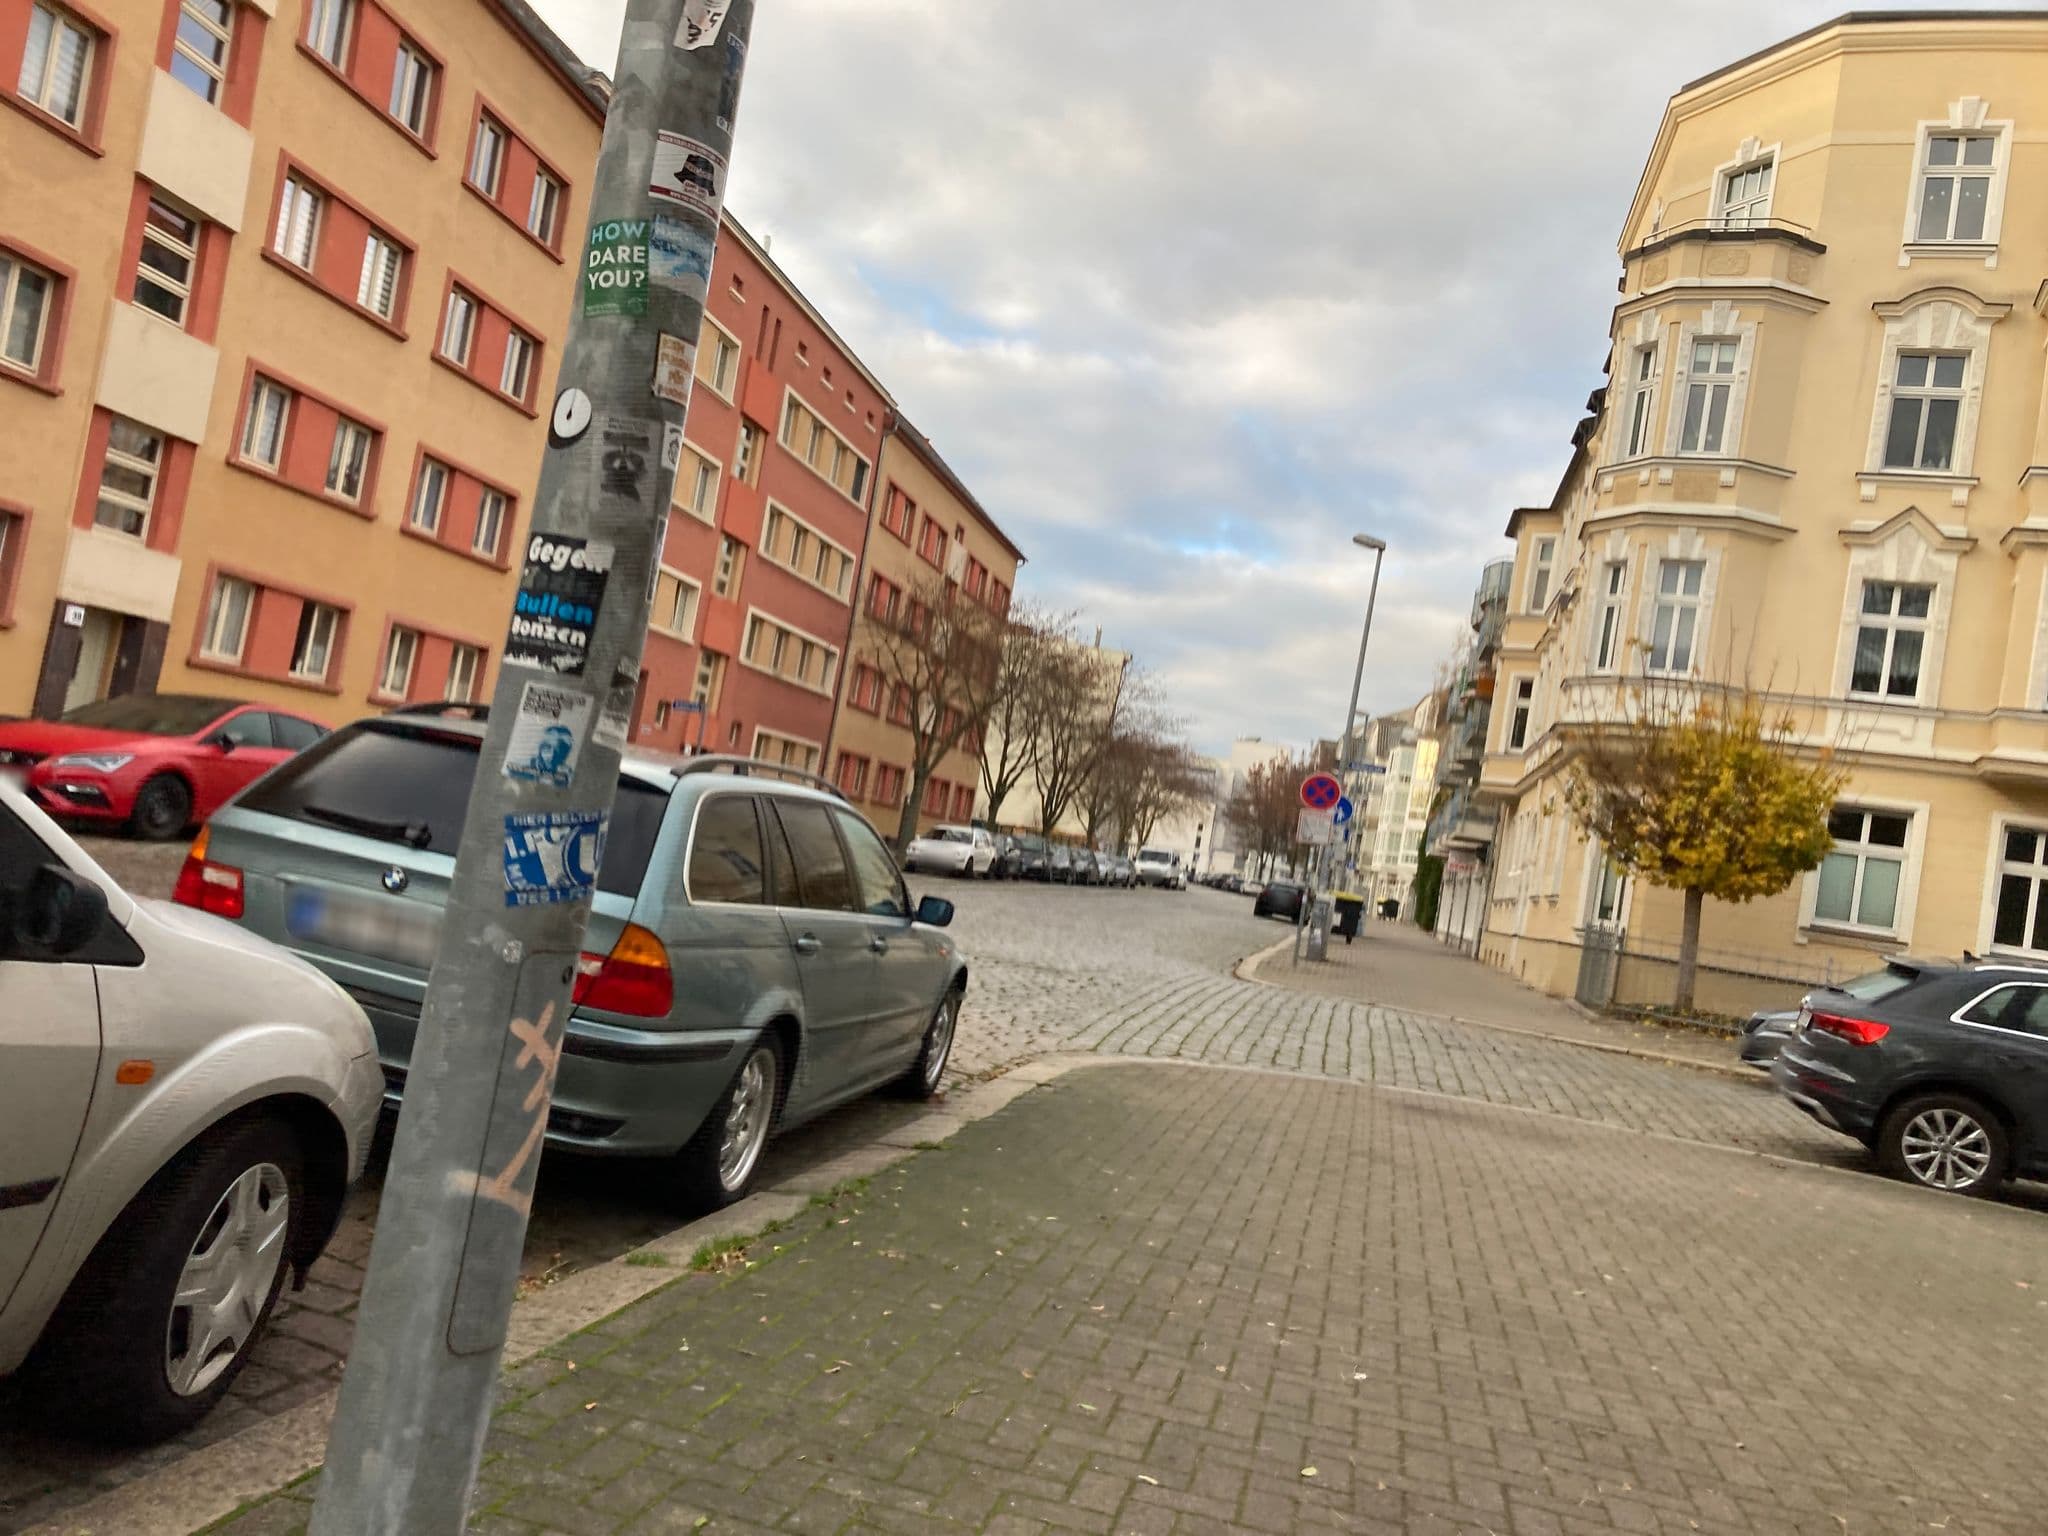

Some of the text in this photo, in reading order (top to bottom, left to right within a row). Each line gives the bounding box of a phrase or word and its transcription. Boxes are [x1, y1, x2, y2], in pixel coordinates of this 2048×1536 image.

[591, 221, 646, 245] HOW
[589, 245, 646, 268] DARE
[588, 269, 645, 291] YOU?
[528, 535, 604, 574] Gege
[511, 614, 587, 648] Bonzen
